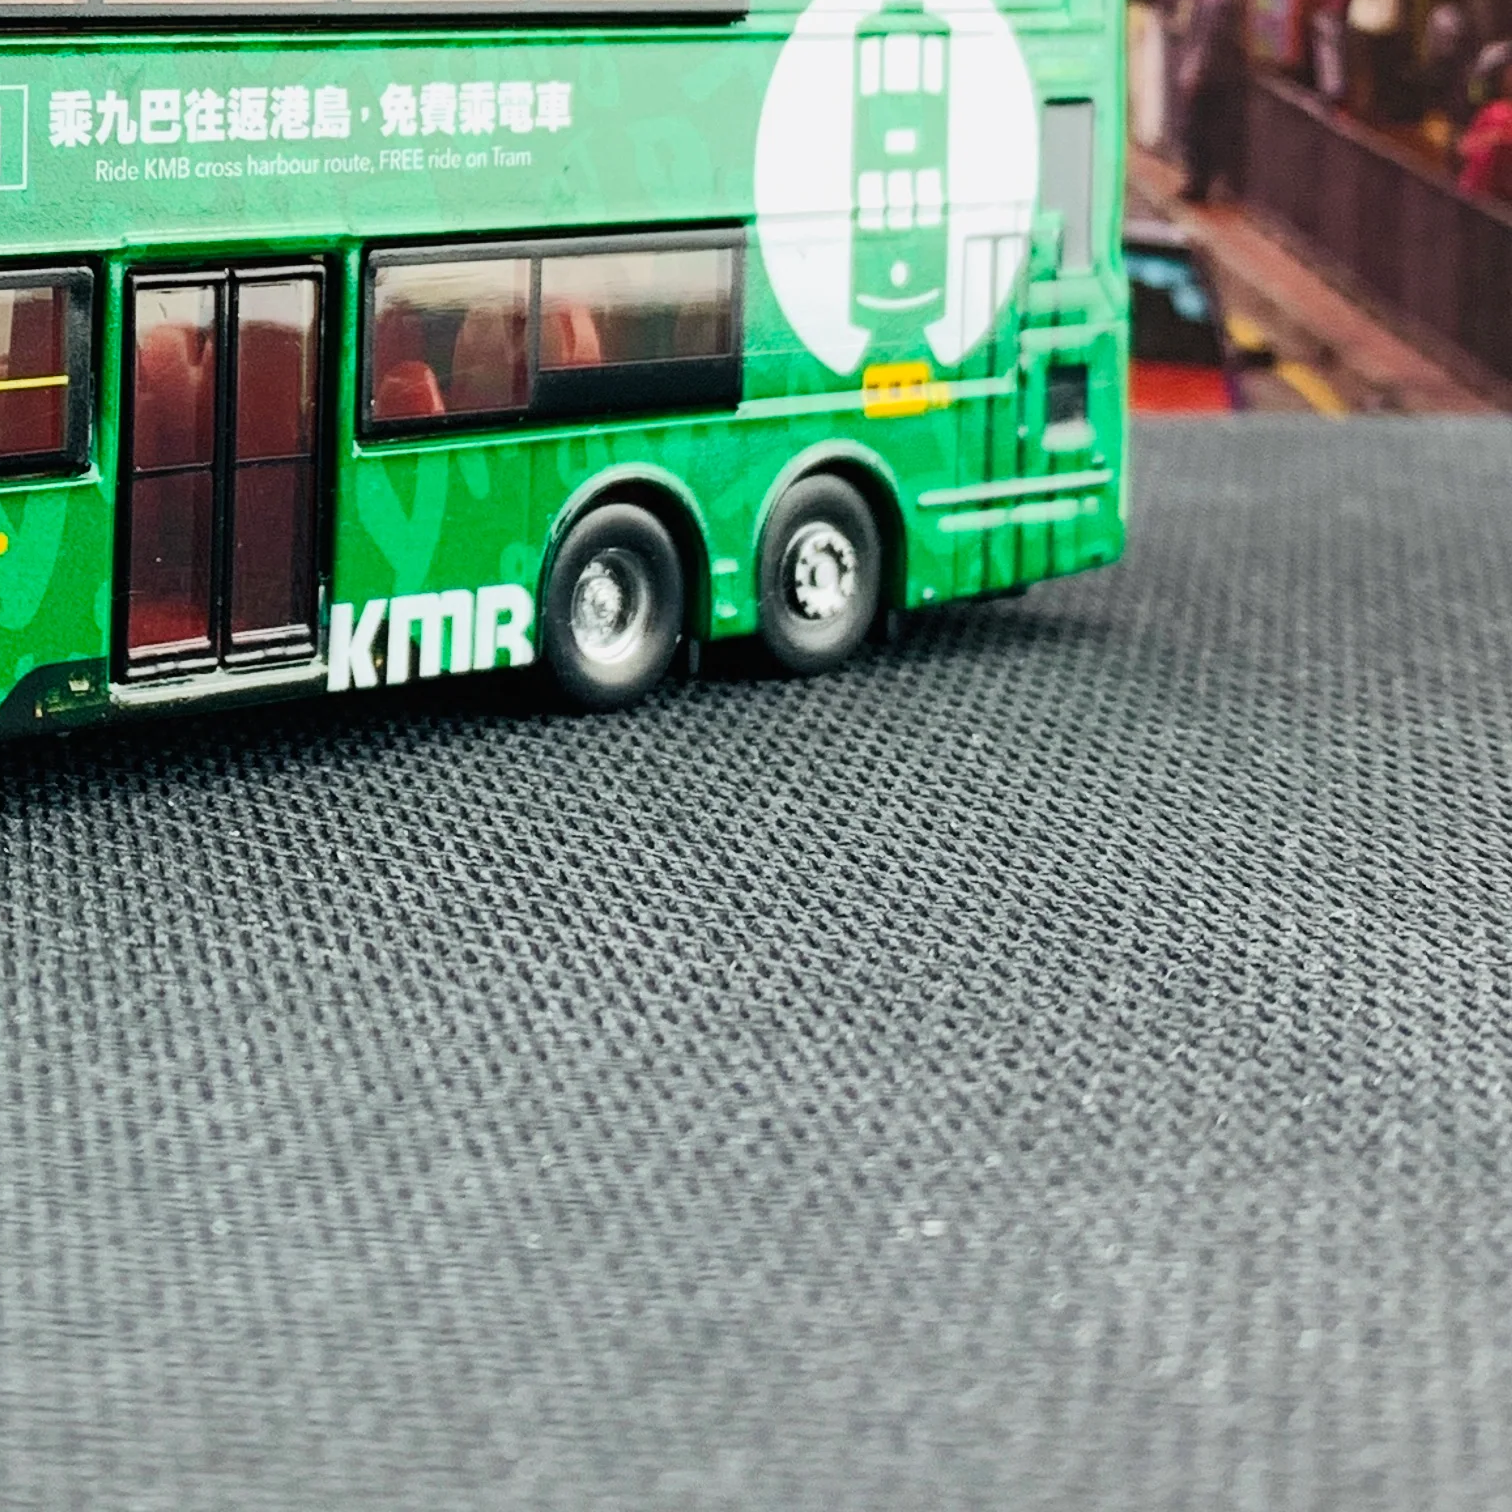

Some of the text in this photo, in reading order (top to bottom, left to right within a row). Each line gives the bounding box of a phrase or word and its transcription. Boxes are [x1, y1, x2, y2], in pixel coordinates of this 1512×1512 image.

[95, 146, 532, 182] Ride KMB cross harbour route, FREE ride on Tram
